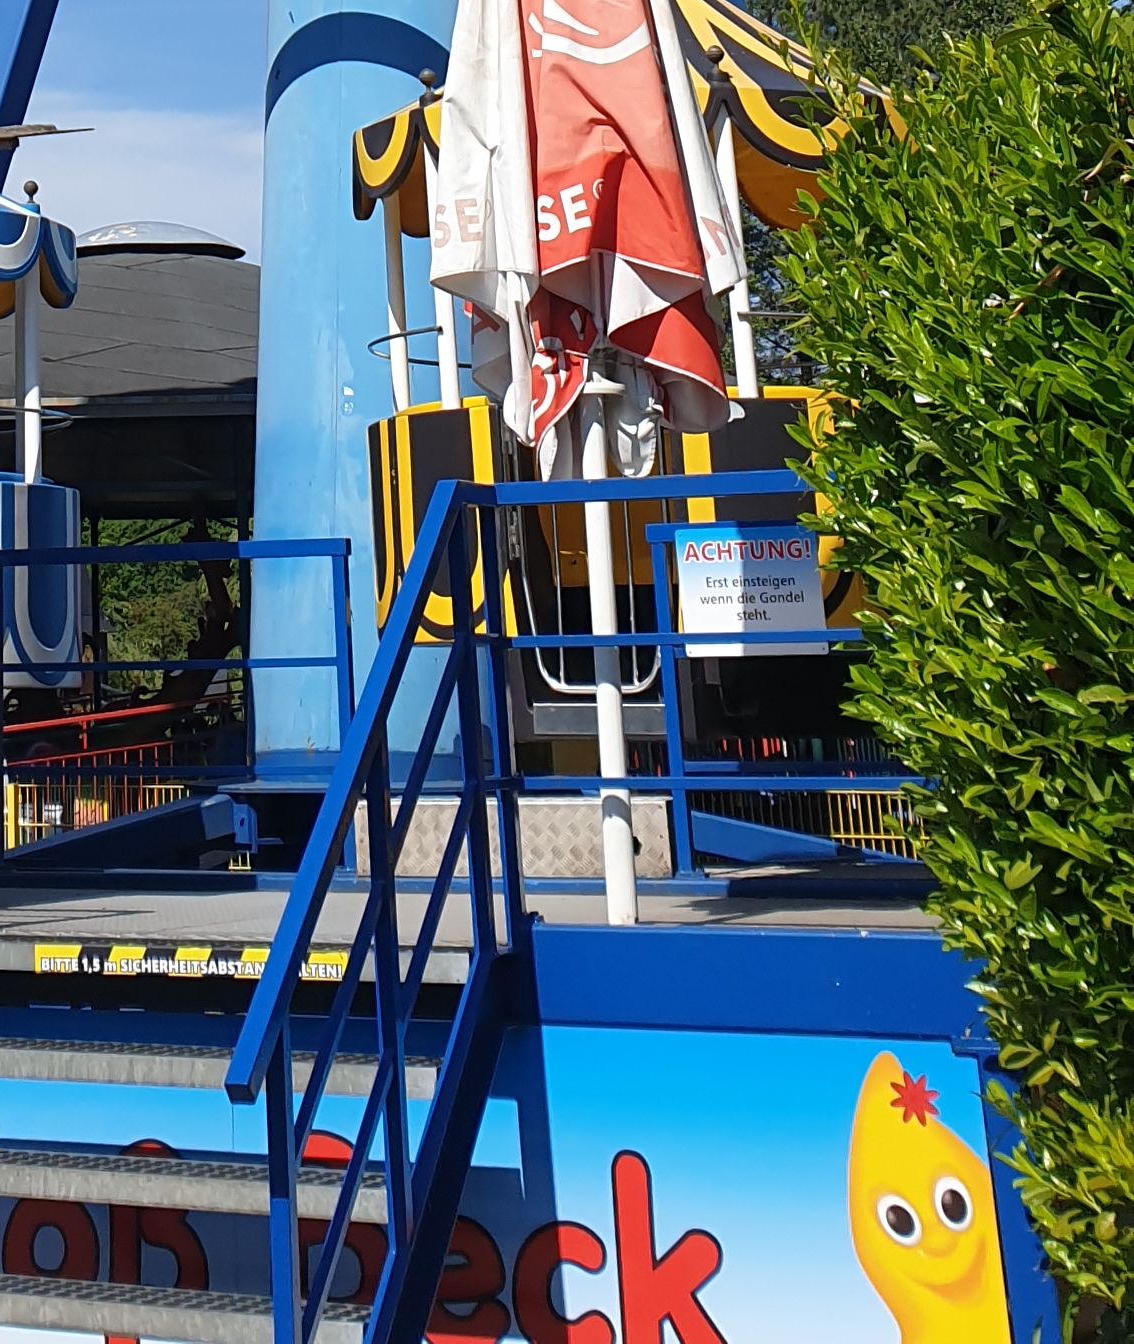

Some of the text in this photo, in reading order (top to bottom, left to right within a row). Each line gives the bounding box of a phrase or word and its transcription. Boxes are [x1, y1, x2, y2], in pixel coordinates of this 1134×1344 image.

[684, 539, 811, 562] ACHTUNG!
[706, 575, 796, 589] Erst einsteigen
[700, 591, 804, 604] wenn die Gondel
[737, 609, 771, 621] steht.
[40, 957, 343, 977] BITTE 1,5 m SICHERHEITSABSTAN LTEN!
